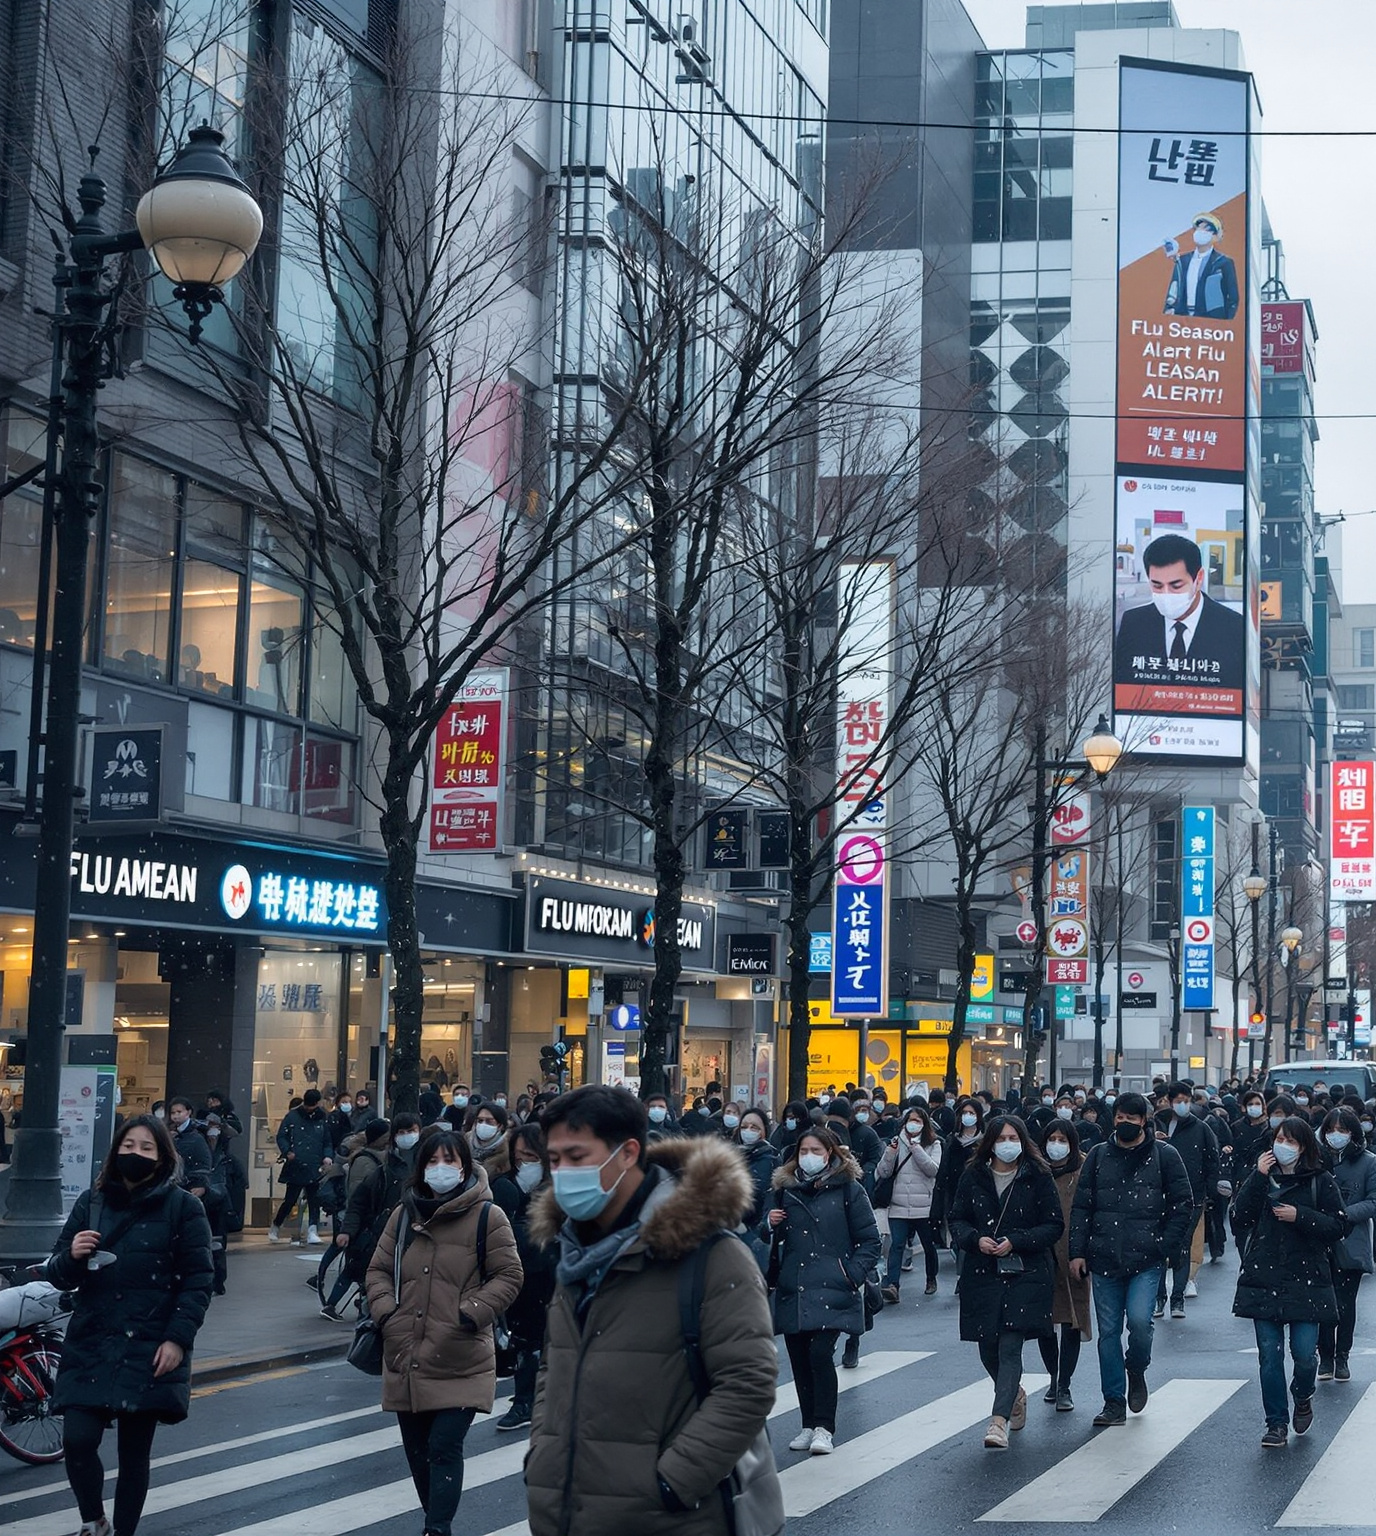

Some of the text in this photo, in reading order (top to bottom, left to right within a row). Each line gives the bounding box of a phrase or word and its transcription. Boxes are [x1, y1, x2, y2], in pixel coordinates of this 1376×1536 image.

[1169, 322, 1234, 342] Season
[113, 858, 197, 902] AMEAN
[541, 897, 574, 931] FLU
